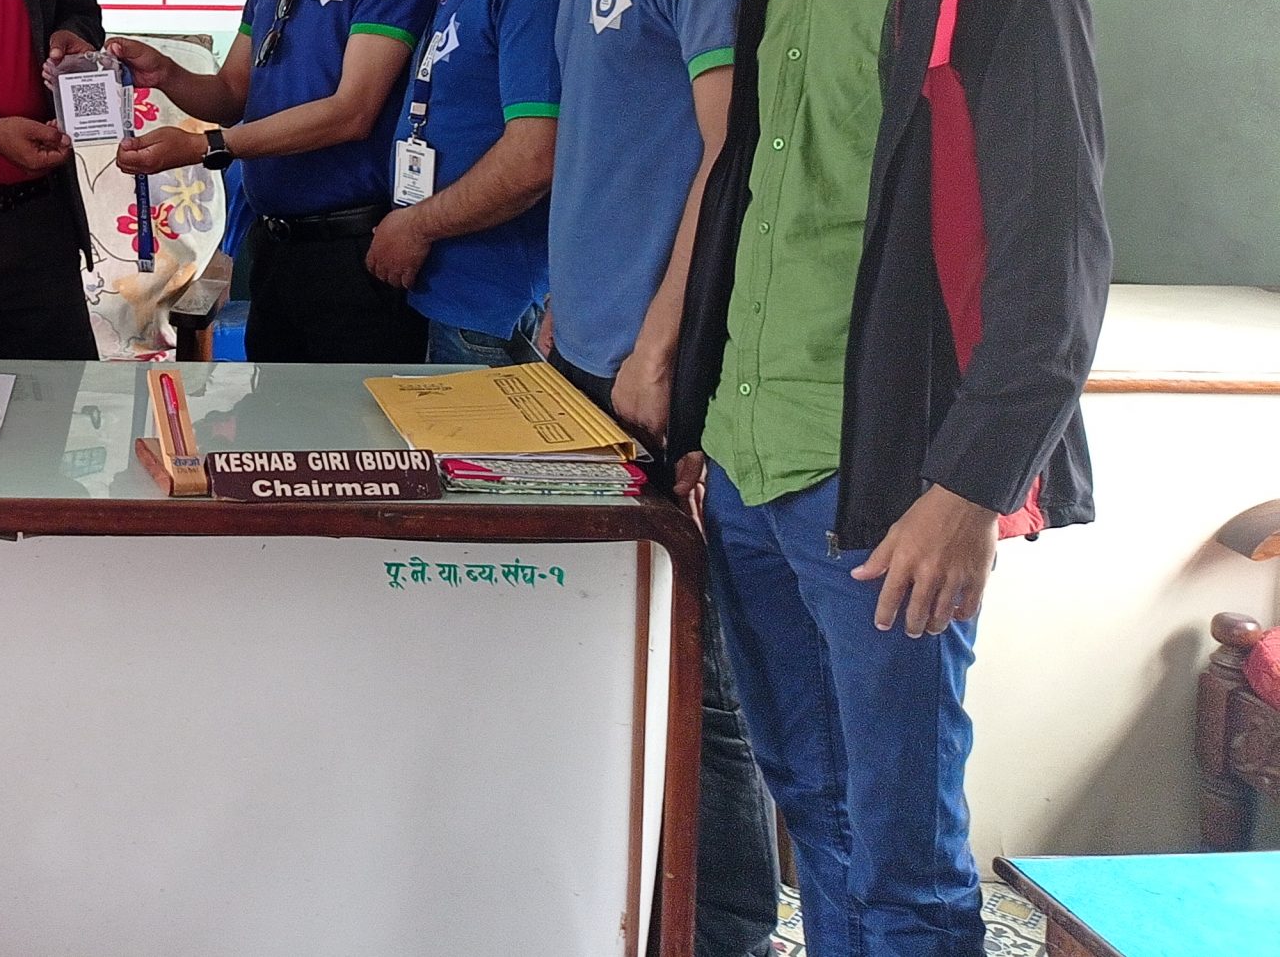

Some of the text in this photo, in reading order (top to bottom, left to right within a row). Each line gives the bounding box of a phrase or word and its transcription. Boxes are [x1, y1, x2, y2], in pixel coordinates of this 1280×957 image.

[214, 452, 297, 472] KESHAB
[307, 451, 351, 472] GIRI
[355, 450, 431, 472] (BIDUR)
[251, 479, 400, 497] Chairman
